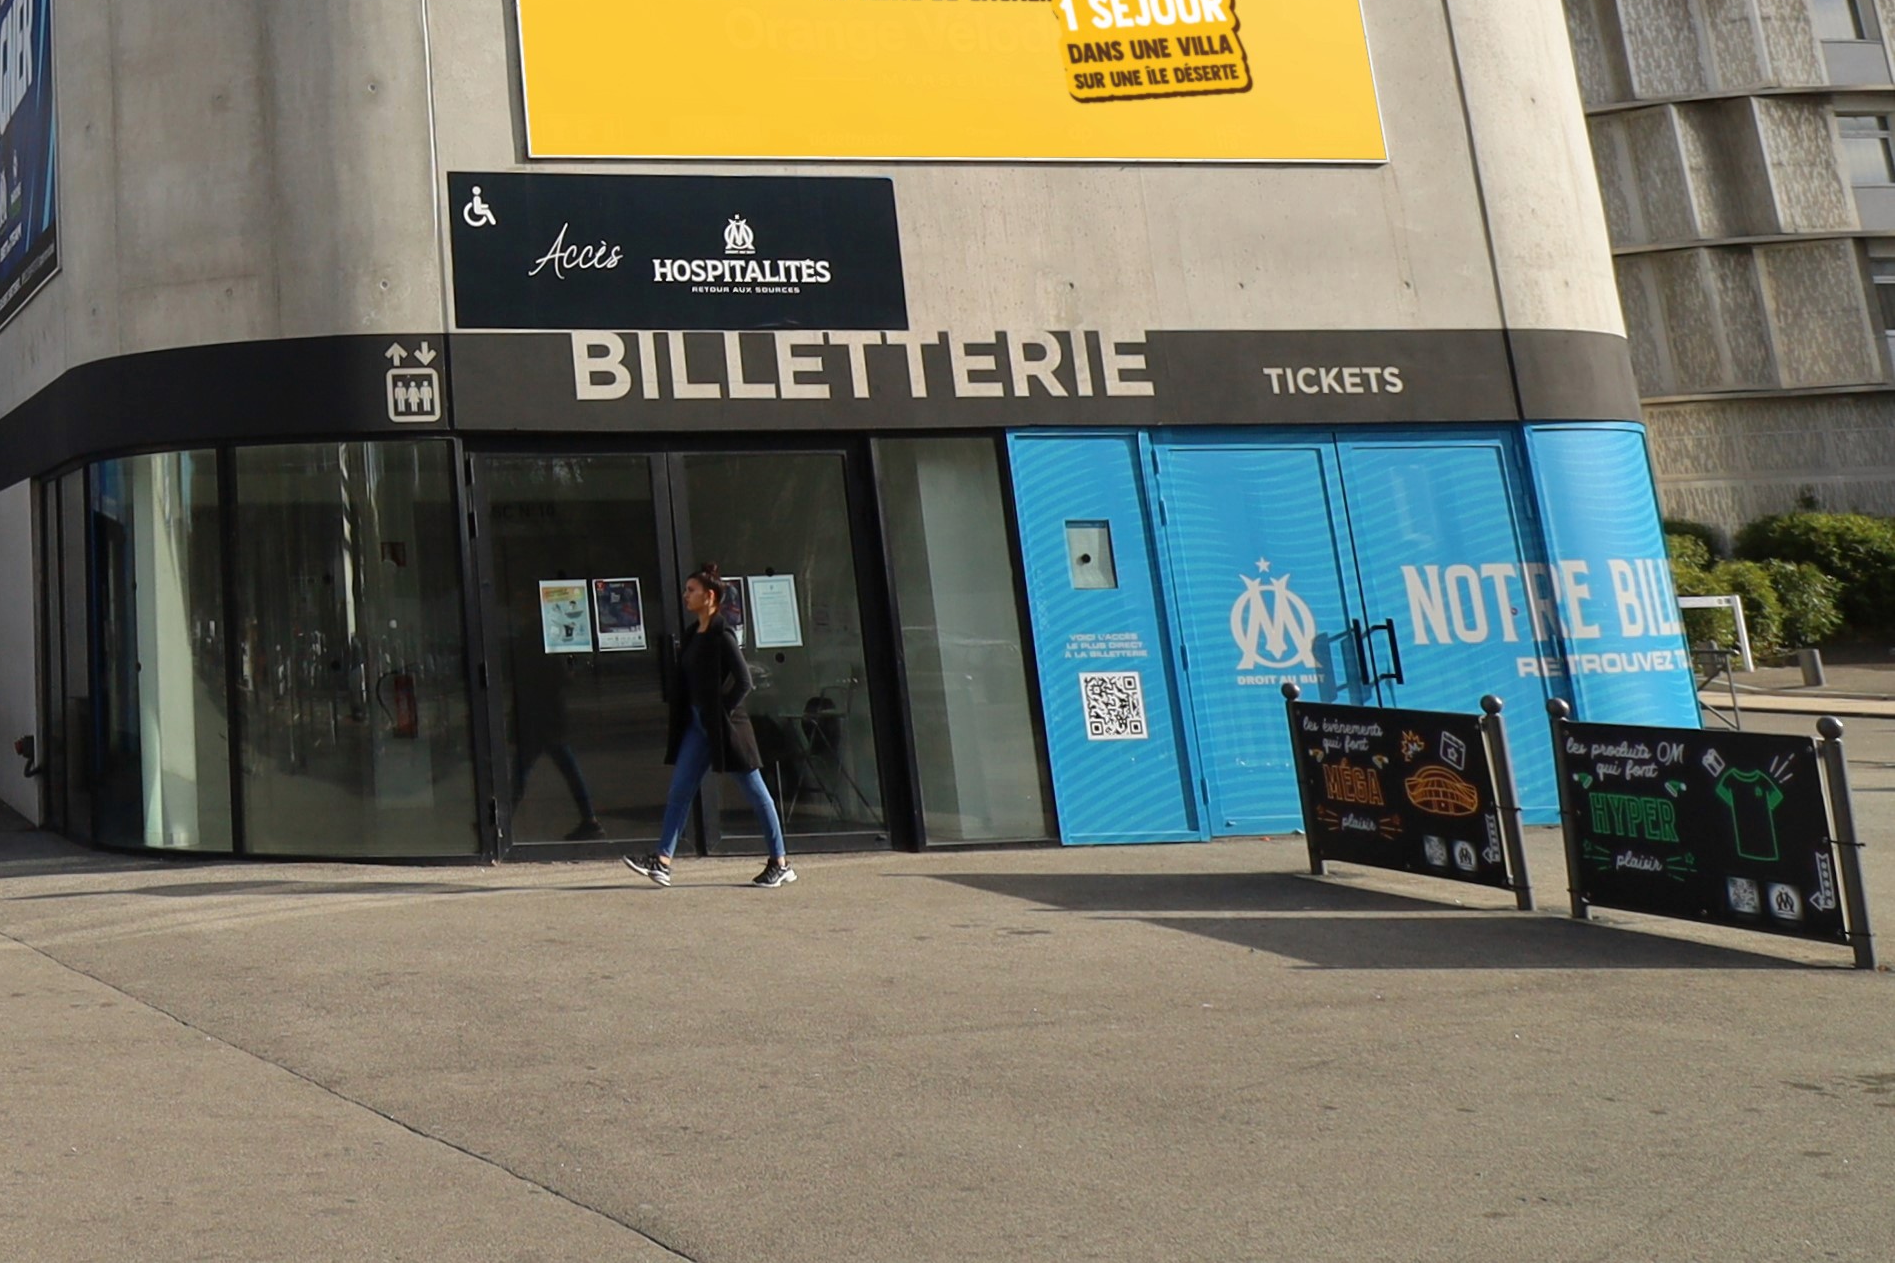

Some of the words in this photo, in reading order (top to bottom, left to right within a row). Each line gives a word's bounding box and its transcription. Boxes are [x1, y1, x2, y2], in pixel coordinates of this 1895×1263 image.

[1067, 41, 1124, 64] DANS
[1130, 37, 1172, 61] UNE
[1176, 34, 1234, 58] VILLA
[1073, 72, 1105, 90] SUR
[1109, 69, 1143, 87] UNE
[1145, 65, 1169, 85] ÎLE
[1173, 62, 1239, 84] DÉSERTE
[527, 222, 624, 280] Accès
[652, 258, 832, 284] HOSPITALITÉS
[732, 286, 753, 294] AUX
[755, 286, 801, 294] SOURCES
[570, 330, 1156, 400] BILLETTERIE
[1262, 366, 1404, 395] TICKETS
[1400, 559, 1601, 645] NOTRE
[1090, 649, 1147, 658] BILLETTERIE
[1108, 641, 1143, 649] DIRECT
[1516, 651, 1674, 677] RETROUVEZ
[1237, 675, 1276, 685] DROIT
[1279, 675, 1297, 685] AU
[1300, 674, 1325, 683] BUT
[1303, 715, 1319, 732] les
[1322, 737, 1342, 754] qui
[1344, 735, 1370, 753] font
[1566, 737, 1587, 754] les
[1591, 741, 1652, 759] produits
[1657, 741, 1685, 766] OM
[1322, 757, 1384, 806] MÉGA
[1596, 761, 1621, 781] qui
[1625, 759, 1658, 780] font
[1341, 813, 1377, 831] plaisir
[1589, 792, 1679, 843] HYPER
[1616, 850, 1663, 871] plaisir
